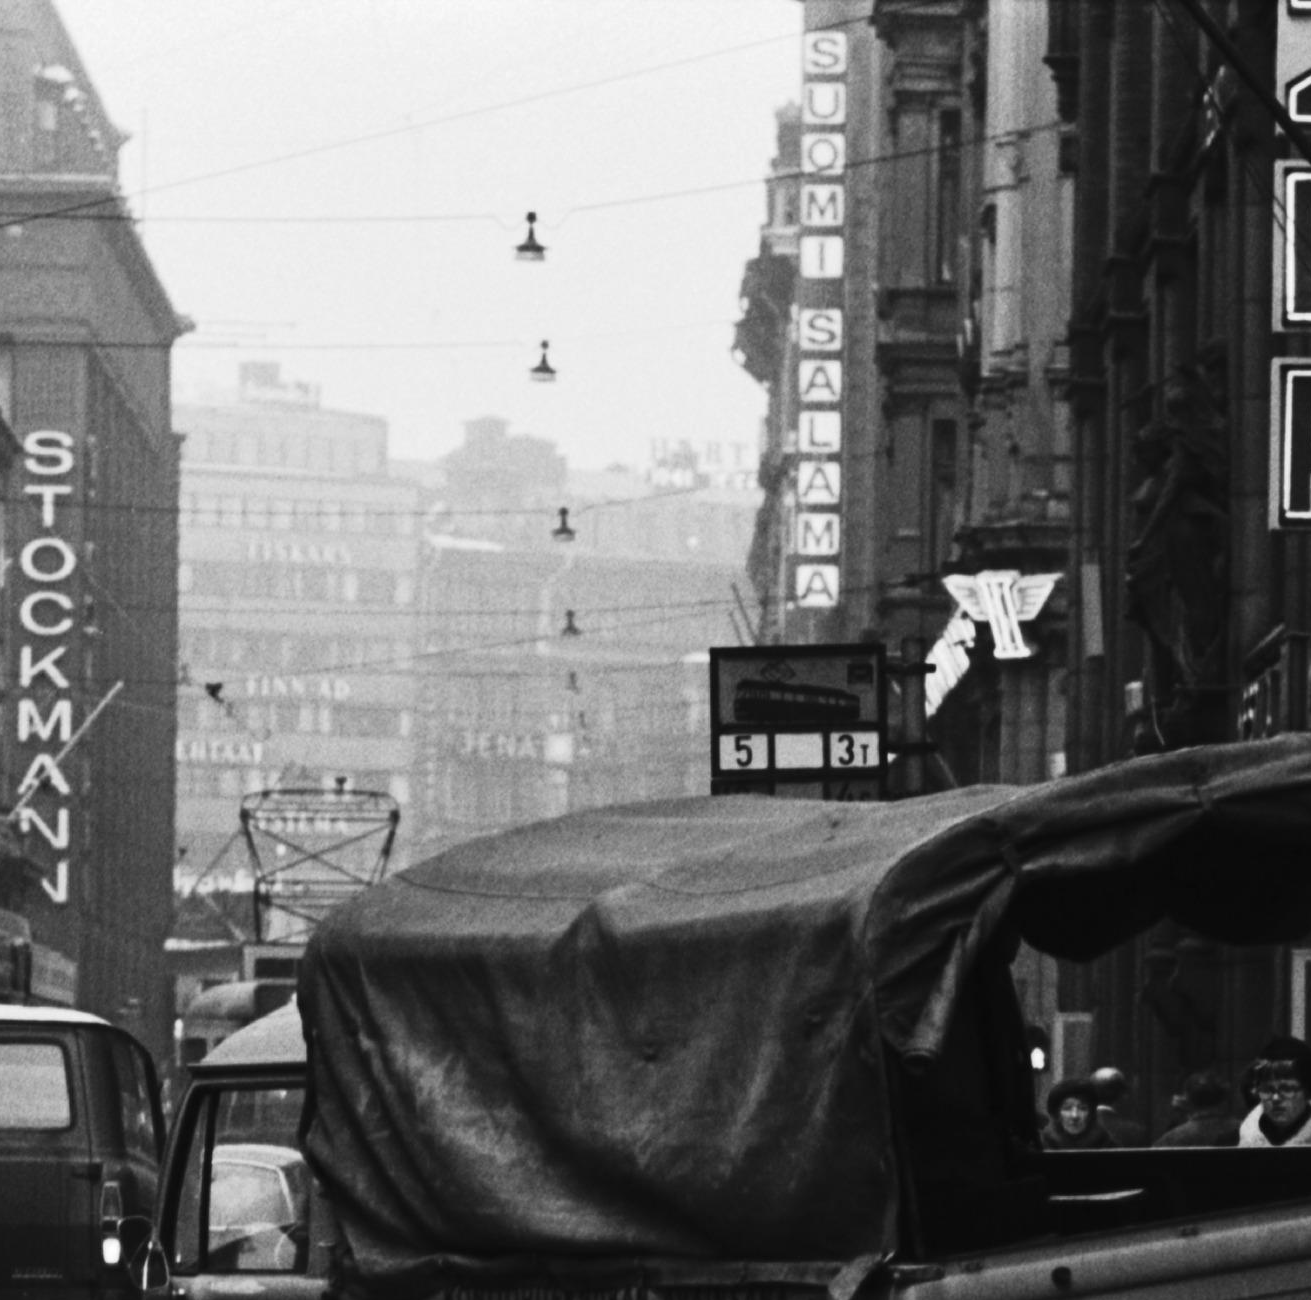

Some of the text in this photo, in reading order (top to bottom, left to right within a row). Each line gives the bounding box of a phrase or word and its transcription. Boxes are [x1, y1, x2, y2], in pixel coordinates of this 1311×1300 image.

[802, 36, 841, 602] SUOMI SALAMA
[16, 429, 77, 905] STOCKMANN
[734, 735, 754, 767] 5
